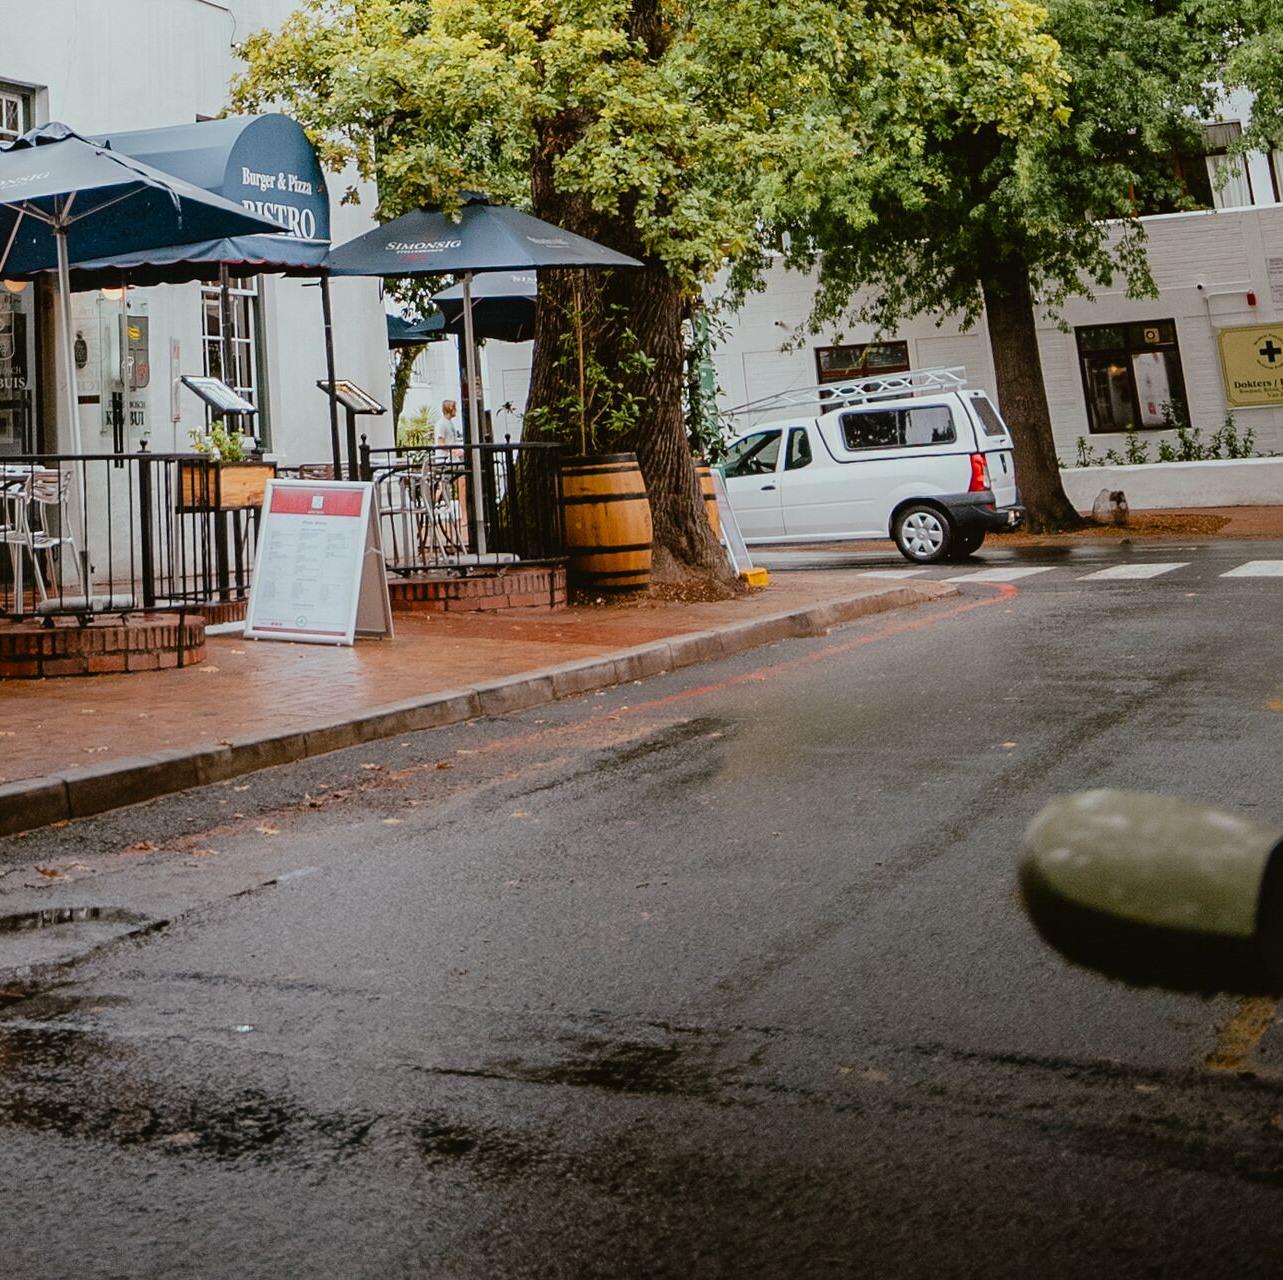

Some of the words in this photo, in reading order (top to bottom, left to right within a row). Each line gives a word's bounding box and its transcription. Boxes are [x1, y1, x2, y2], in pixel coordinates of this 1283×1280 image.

[241, 167, 276, 192] Burger
[277, 172, 287, 191] &
[287, 174, 312, 196] Pizza
[385, 240, 462, 251] SIMONSIG
[1234, 380, 1272, 389] Dokters
